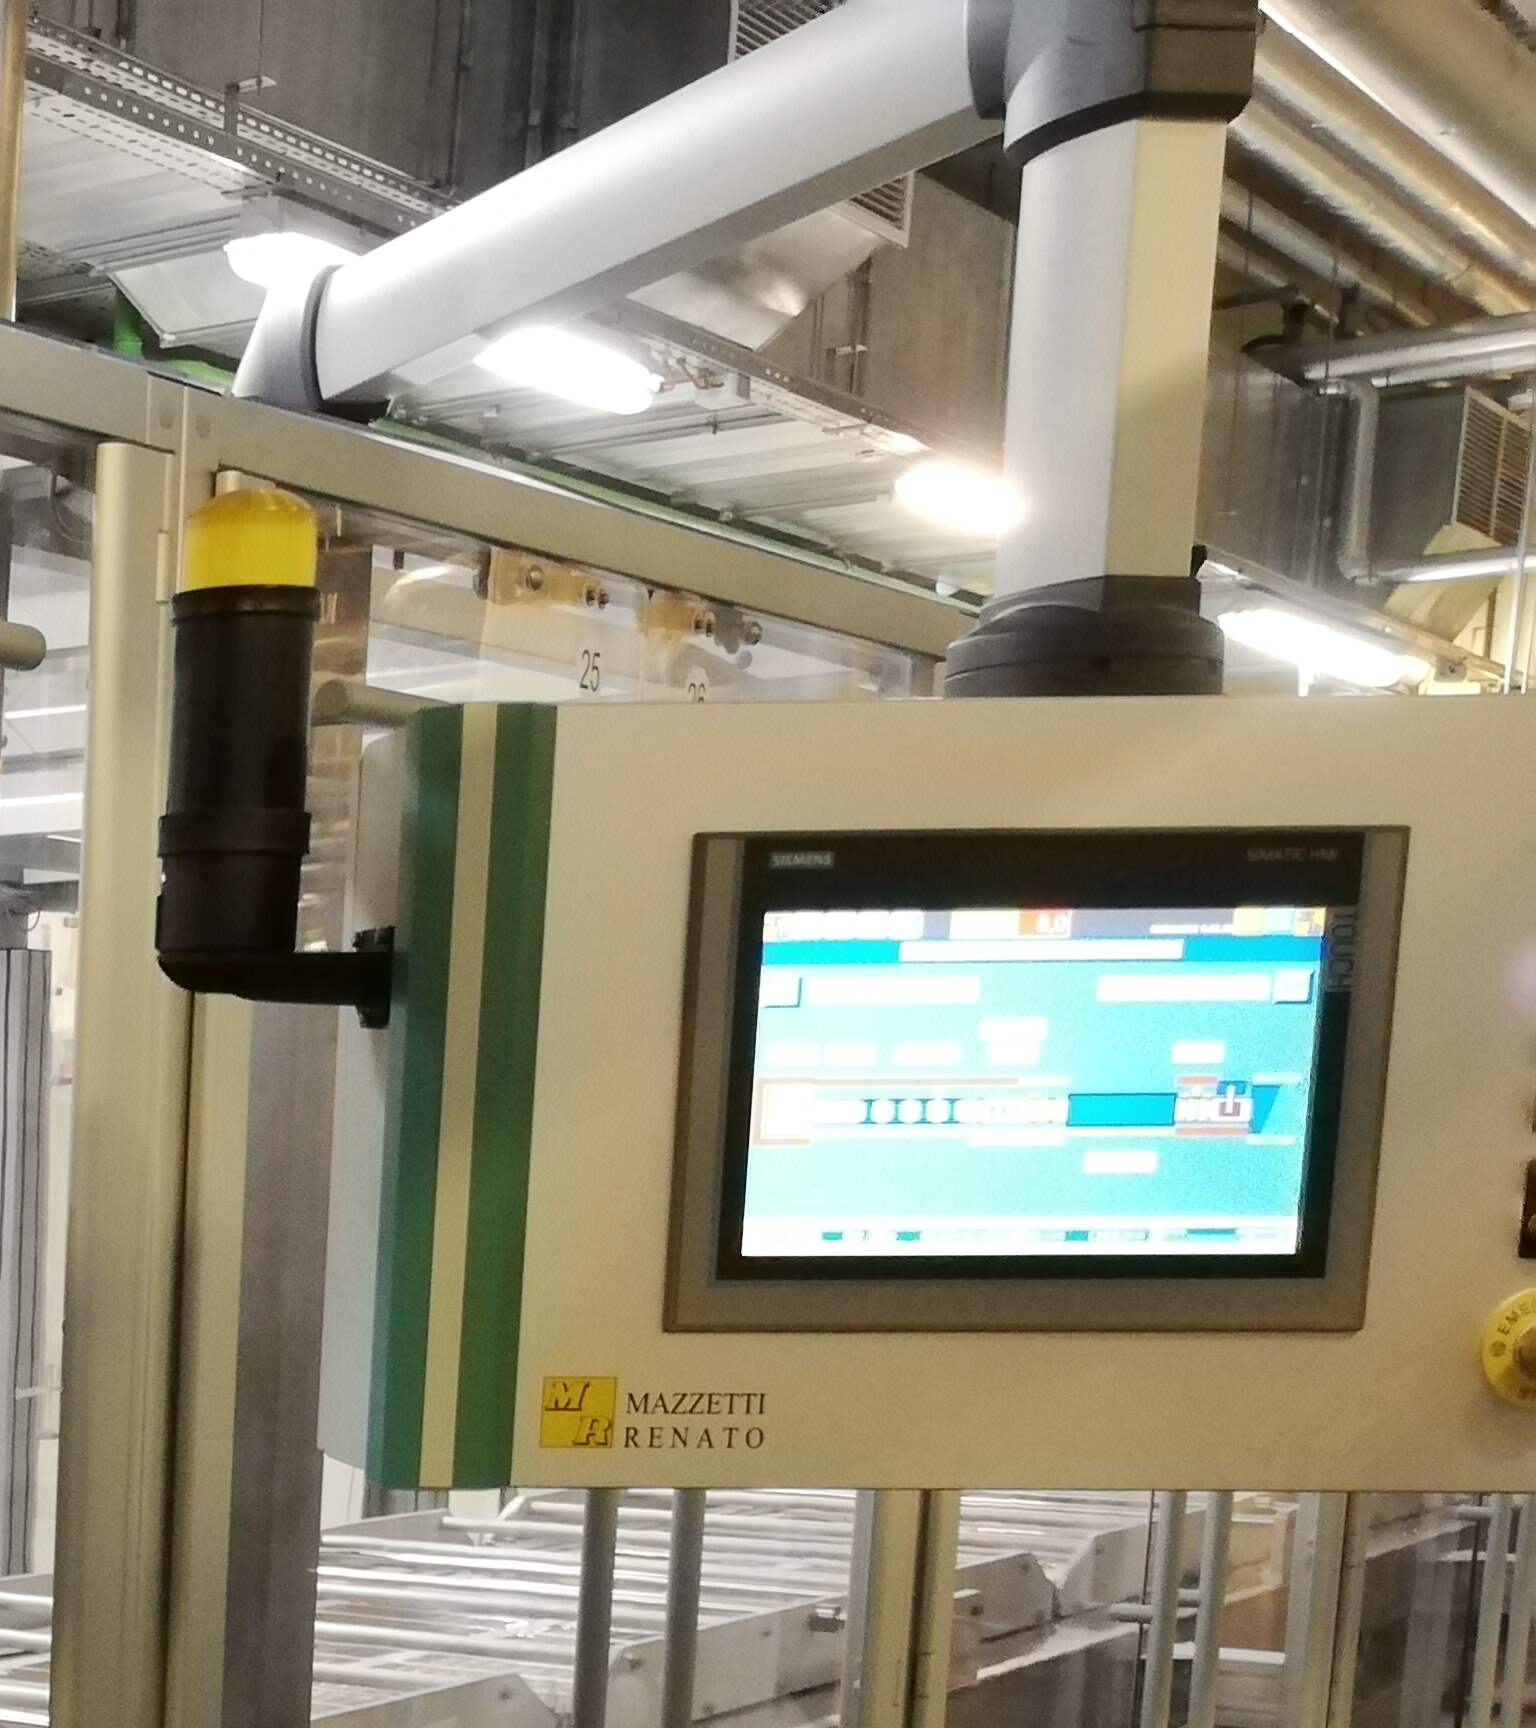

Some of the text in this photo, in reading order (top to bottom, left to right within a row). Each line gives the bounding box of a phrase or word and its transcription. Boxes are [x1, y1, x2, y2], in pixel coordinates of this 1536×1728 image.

[579, 649, 601, 692] 25
[625, 1391, 767, 1415] MAZZETTI
[622, 1426, 766, 1449] RENATO
